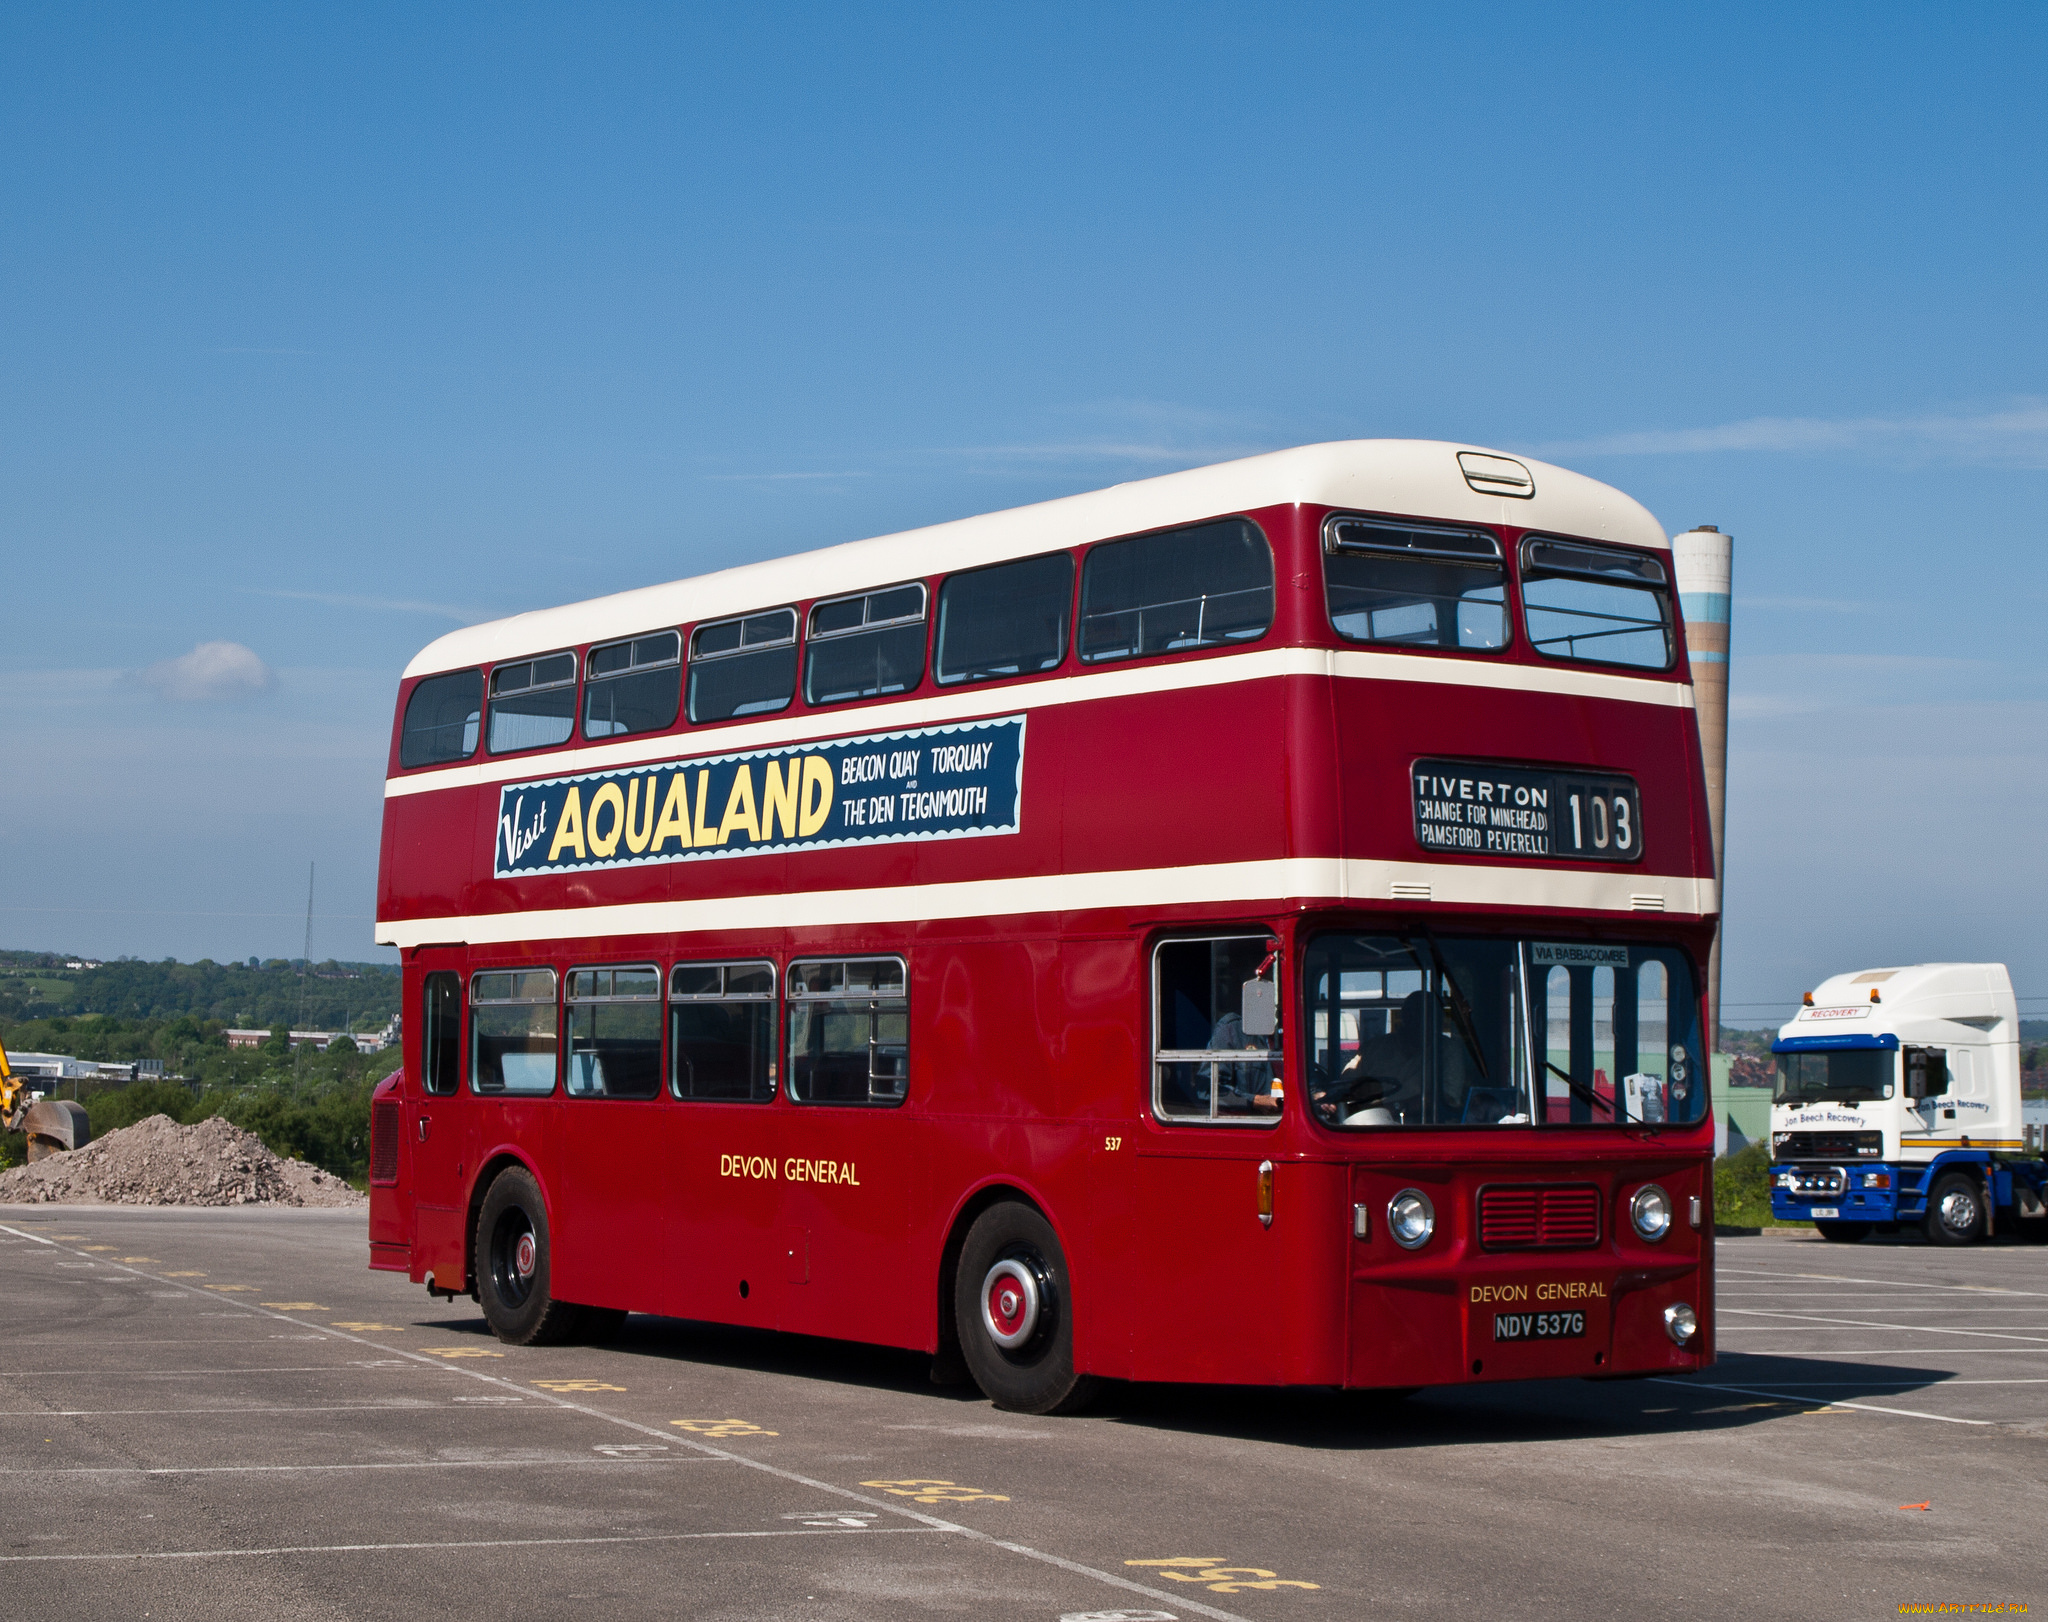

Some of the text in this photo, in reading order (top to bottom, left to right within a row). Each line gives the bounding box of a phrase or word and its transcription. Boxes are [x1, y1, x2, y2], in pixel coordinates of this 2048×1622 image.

[842, 742, 993, 785] BEACON QUAY TORQUAY
[905, 780, 918, 789] AND
[1415, 775, 1548, 808] TIVERTON
[502, 755, 834, 866] Visit AQUALAND
[842, 787, 987, 827] THE DEN TEIGNMOUTH
[1467, 804, 1487, 826] FOR
[1569, 794, 1632, 850] 103
[1535, 947, 1627, 963] VIA BABBACOMBE
[1811, 1008, 1860, 1018] RECOVERY
[1931, 1099, 1956, 1110] Beech
[1957, 1099, 1990, 1113] Recovery
[1784, 1112, 1866, 1127] Jon Beech Recovery
[1105, 1136, 1122, 1151] 537
[720, 1154, 860, 1186] DEVON GENERAL
[1471, 1282, 1607, 1302] DEVON GENERAL
[1496, 1313, 1584, 1338] NDV 537G
